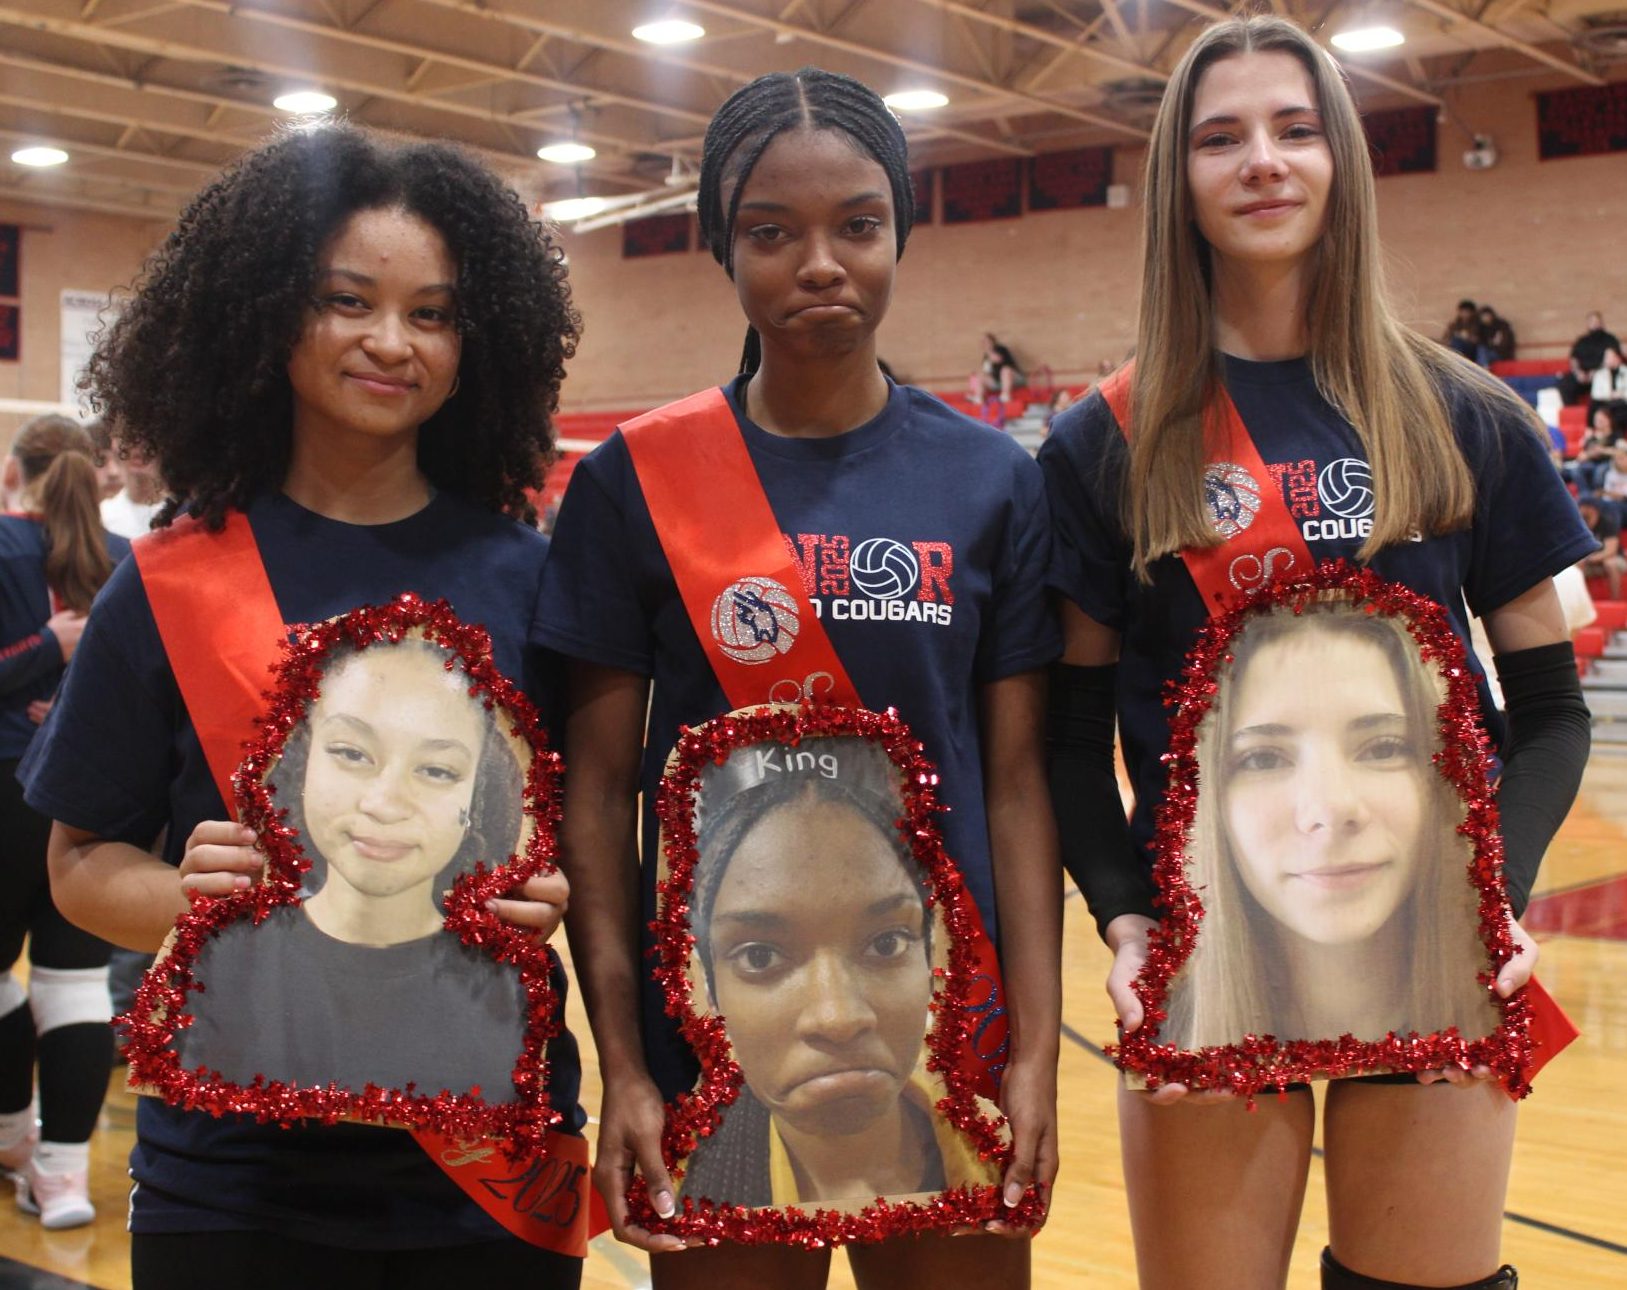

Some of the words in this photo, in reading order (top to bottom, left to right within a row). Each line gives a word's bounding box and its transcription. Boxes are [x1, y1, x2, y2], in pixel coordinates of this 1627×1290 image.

[1288, 459, 1320, 518] 2025
[820, 534, 849, 595] 2025
[832, 598, 952, 626] COUGARS
[755, 746, 838, 779] King
[478, 1156, 587, 1227] 2025
